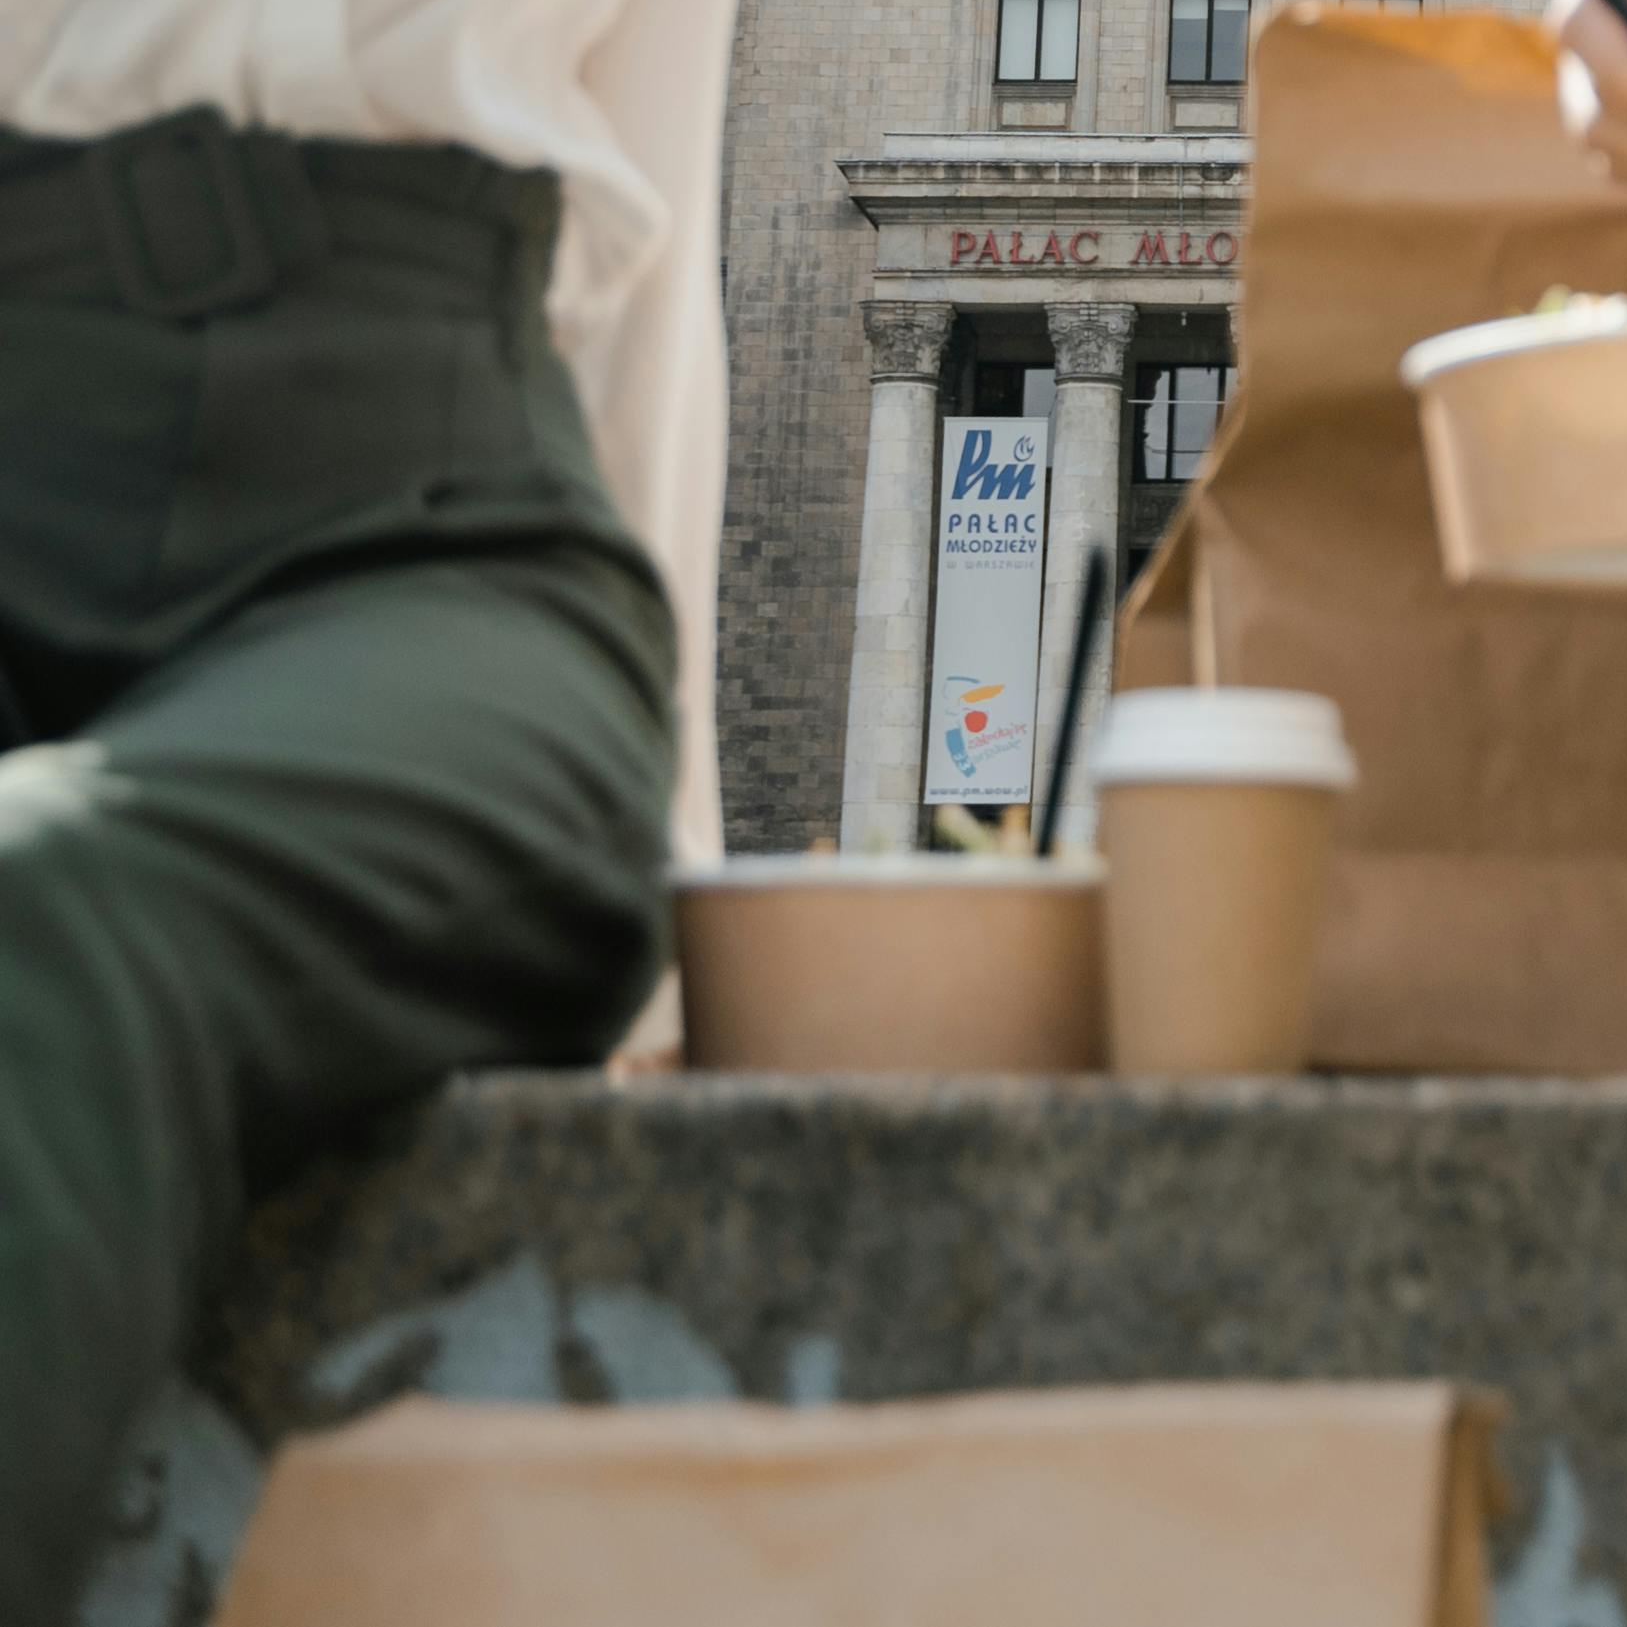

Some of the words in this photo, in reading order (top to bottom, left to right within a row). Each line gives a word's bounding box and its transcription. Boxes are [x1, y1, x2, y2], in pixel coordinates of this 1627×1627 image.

[950, 230, 1100, 264] PAŁAC
[1129, 230, 1239, 265] MŁO
[947, 513, 1036, 534] PAŁAC
[946, 534, 1037, 553] MŁODZIEŻY
[964, 559, 1036, 570] WARSZAWIE
[929, 785, 1028, 797] www.pm.wow.pl
